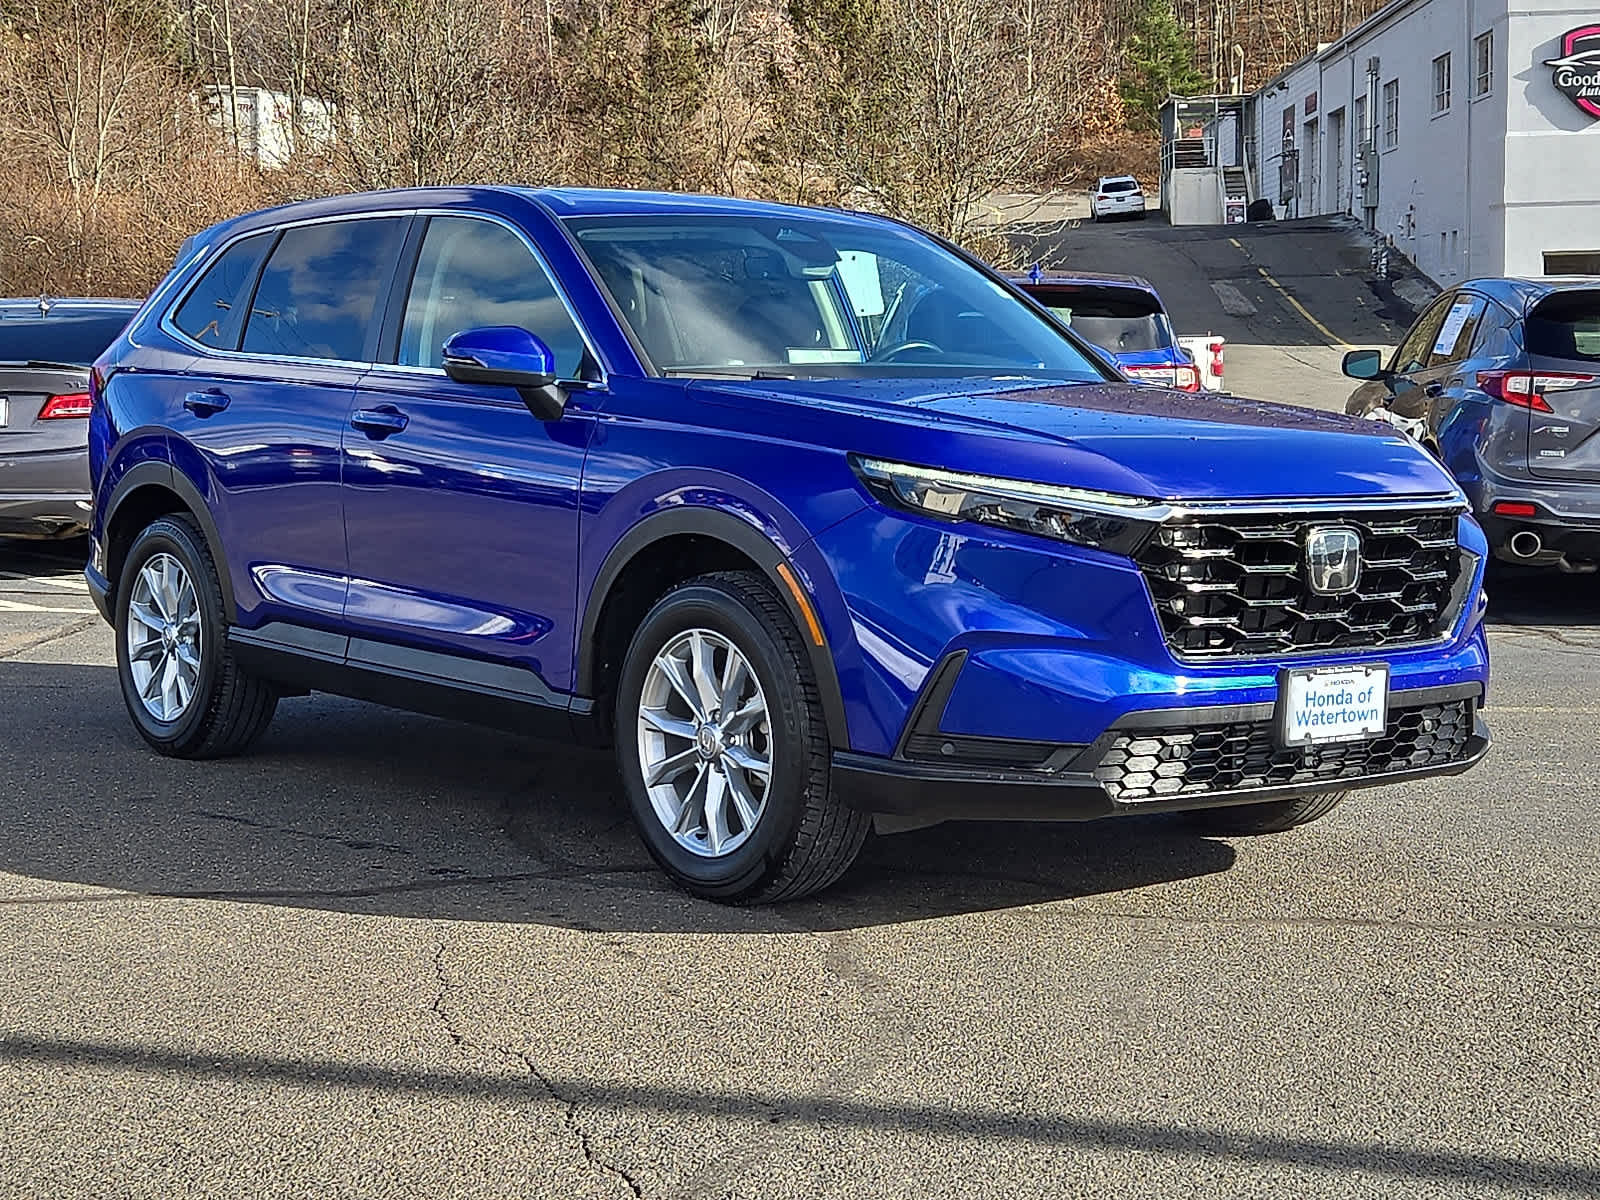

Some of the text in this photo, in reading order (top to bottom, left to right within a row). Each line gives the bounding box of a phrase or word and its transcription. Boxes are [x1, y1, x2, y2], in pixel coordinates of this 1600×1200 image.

[1559, 71, 1600, 87] Good
[1576, 86, 1600, 96] Aut
[1305, 686, 1374, 708] Honda of
[1296, 708, 1378, 727] Watertown
